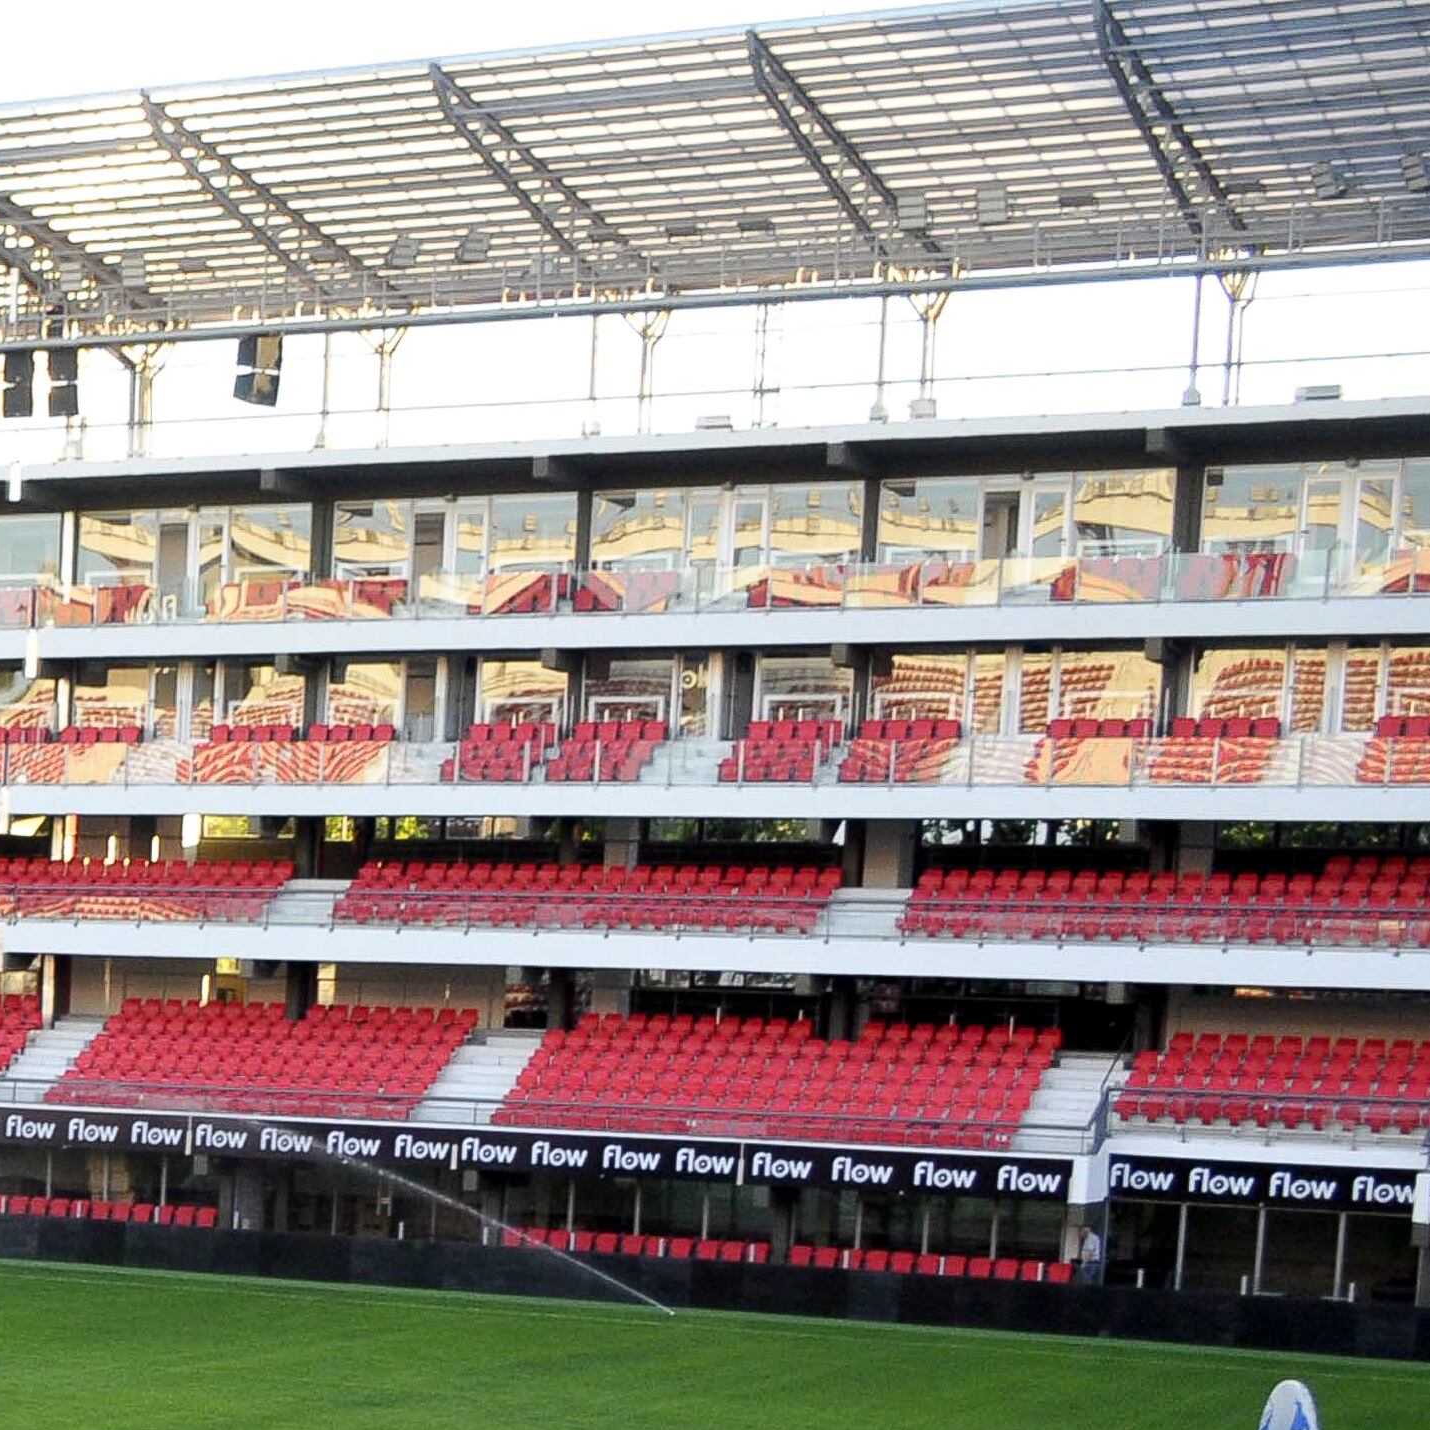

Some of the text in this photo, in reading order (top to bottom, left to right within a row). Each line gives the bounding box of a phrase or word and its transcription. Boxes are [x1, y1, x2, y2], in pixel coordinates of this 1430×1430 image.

[6, 1115, 56, 1140] flow
[68, 1118, 119, 1143] flow
[131, 1121, 183, 1146] flow
[195, 1124, 248, 1149] flow
[260, 1128, 314, 1153] flow
[327, 1131, 381, 1156] flow
[394, 1134, 450, 1161] flow
[461, 1137, 518, 1164] flow
[531, 1141, 588, 1168] flow
[602, 1145, 661, 1172] flow
[676, 1148, 735, 1175] flow
[752, 1151, 813, 1180] flow
[831, 1156, 894, 1184] flow
[913, 1161, 978, 1189] flow
[997, 1165, 1062, 1193] flow
[1110, 1163, 1417, 1204] flow flow flow flow
